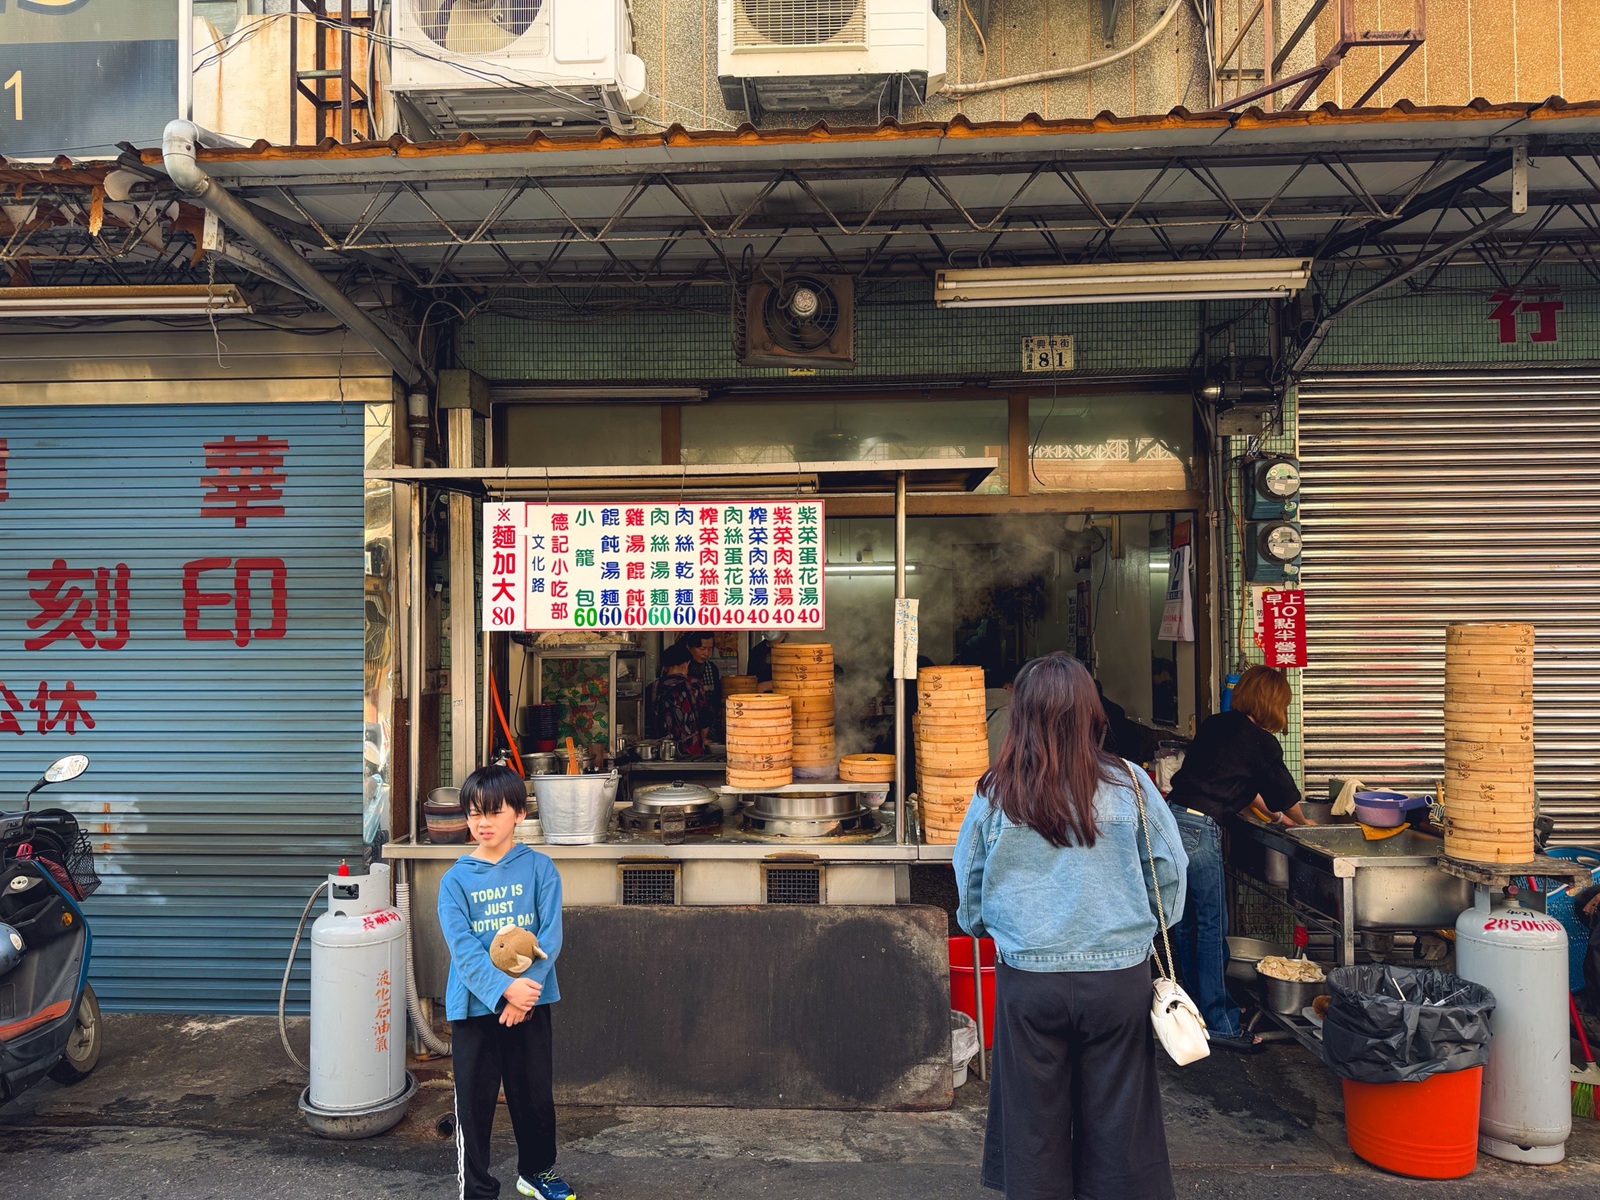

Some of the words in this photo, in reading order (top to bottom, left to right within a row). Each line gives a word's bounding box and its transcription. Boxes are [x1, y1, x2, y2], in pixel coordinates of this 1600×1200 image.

[1484, 284, 1565, 344] 行
[1038, 351, 1066, 368] 81
[200, 434, 290, 528] 華
[531, 534, 546, 593] 文化路
[550, 512, 569, 620] 德記小吃部
[575, 507, 595, 607] 小籠包
[600, 507, 621, 607] 餛飩湯麵
[625, 507, 646, 607] 雞湯餛飩
[650, 507, 670, 607] 肉絲湯麵
[674, 507, 695, 607] 肉絲乾麵
[699, 506, 719, 607] 榨菜肉絲麵
[723, 506, 744, 606] 肉絲蛋花湯
[748, 506, 769, 606] 榨菜肉絲湯
[772, 506, 793, 606] 紫菜肉絲湯
[797, 505, 819, 606] 紫菜蛋花湯
[491, 606, 515, 626] 80
[574, 607, 598, 627] 60
[599, 606, 622, 626] 60
[624, 606, 647, 626] 60
[648, 606, 672, 626] 60
[673, 606, 696, 626] 60
[697, 606, 721, 626] 60
[722, 608, 745, 625] 40
[747, 608, 769, 625] 40
[772, 608, 795, 624] 40
[797, 608, 820, 624] 40
[471, 885, 508, 904] TODAY
[511, 883, 523, 897] IS
[484, 900, 514, 916] JUST
[517, 912, 535, 927] DAY
[372, 970, 391, 1053] 液化石油氣
